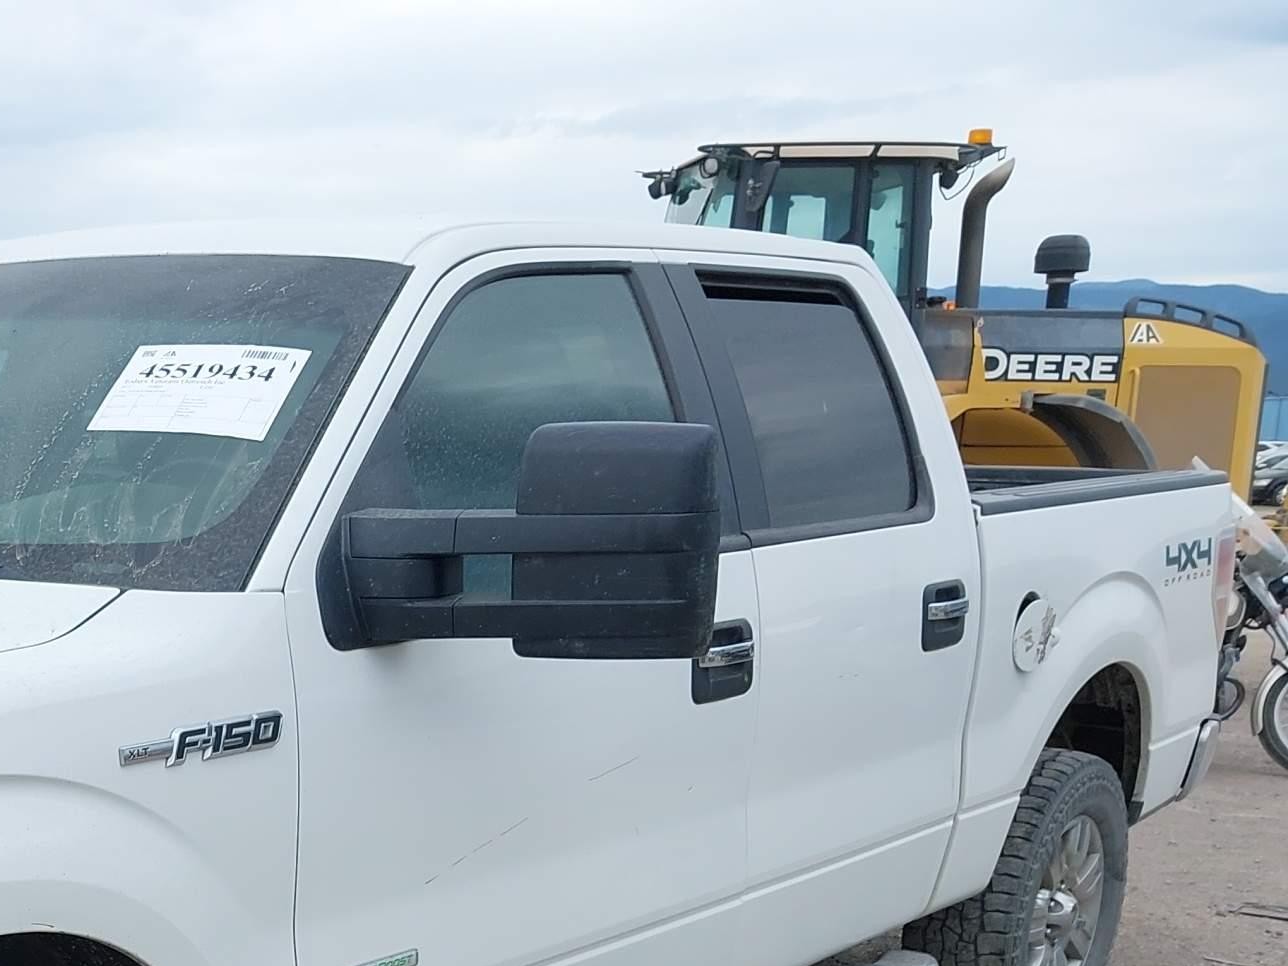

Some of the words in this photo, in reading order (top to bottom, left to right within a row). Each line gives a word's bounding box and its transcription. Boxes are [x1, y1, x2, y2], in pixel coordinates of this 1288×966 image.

[139, 362, 277, 382] 45519434
[982, 348, 1119, 382] DEERE
[127, 747, 150, 761] XLT
